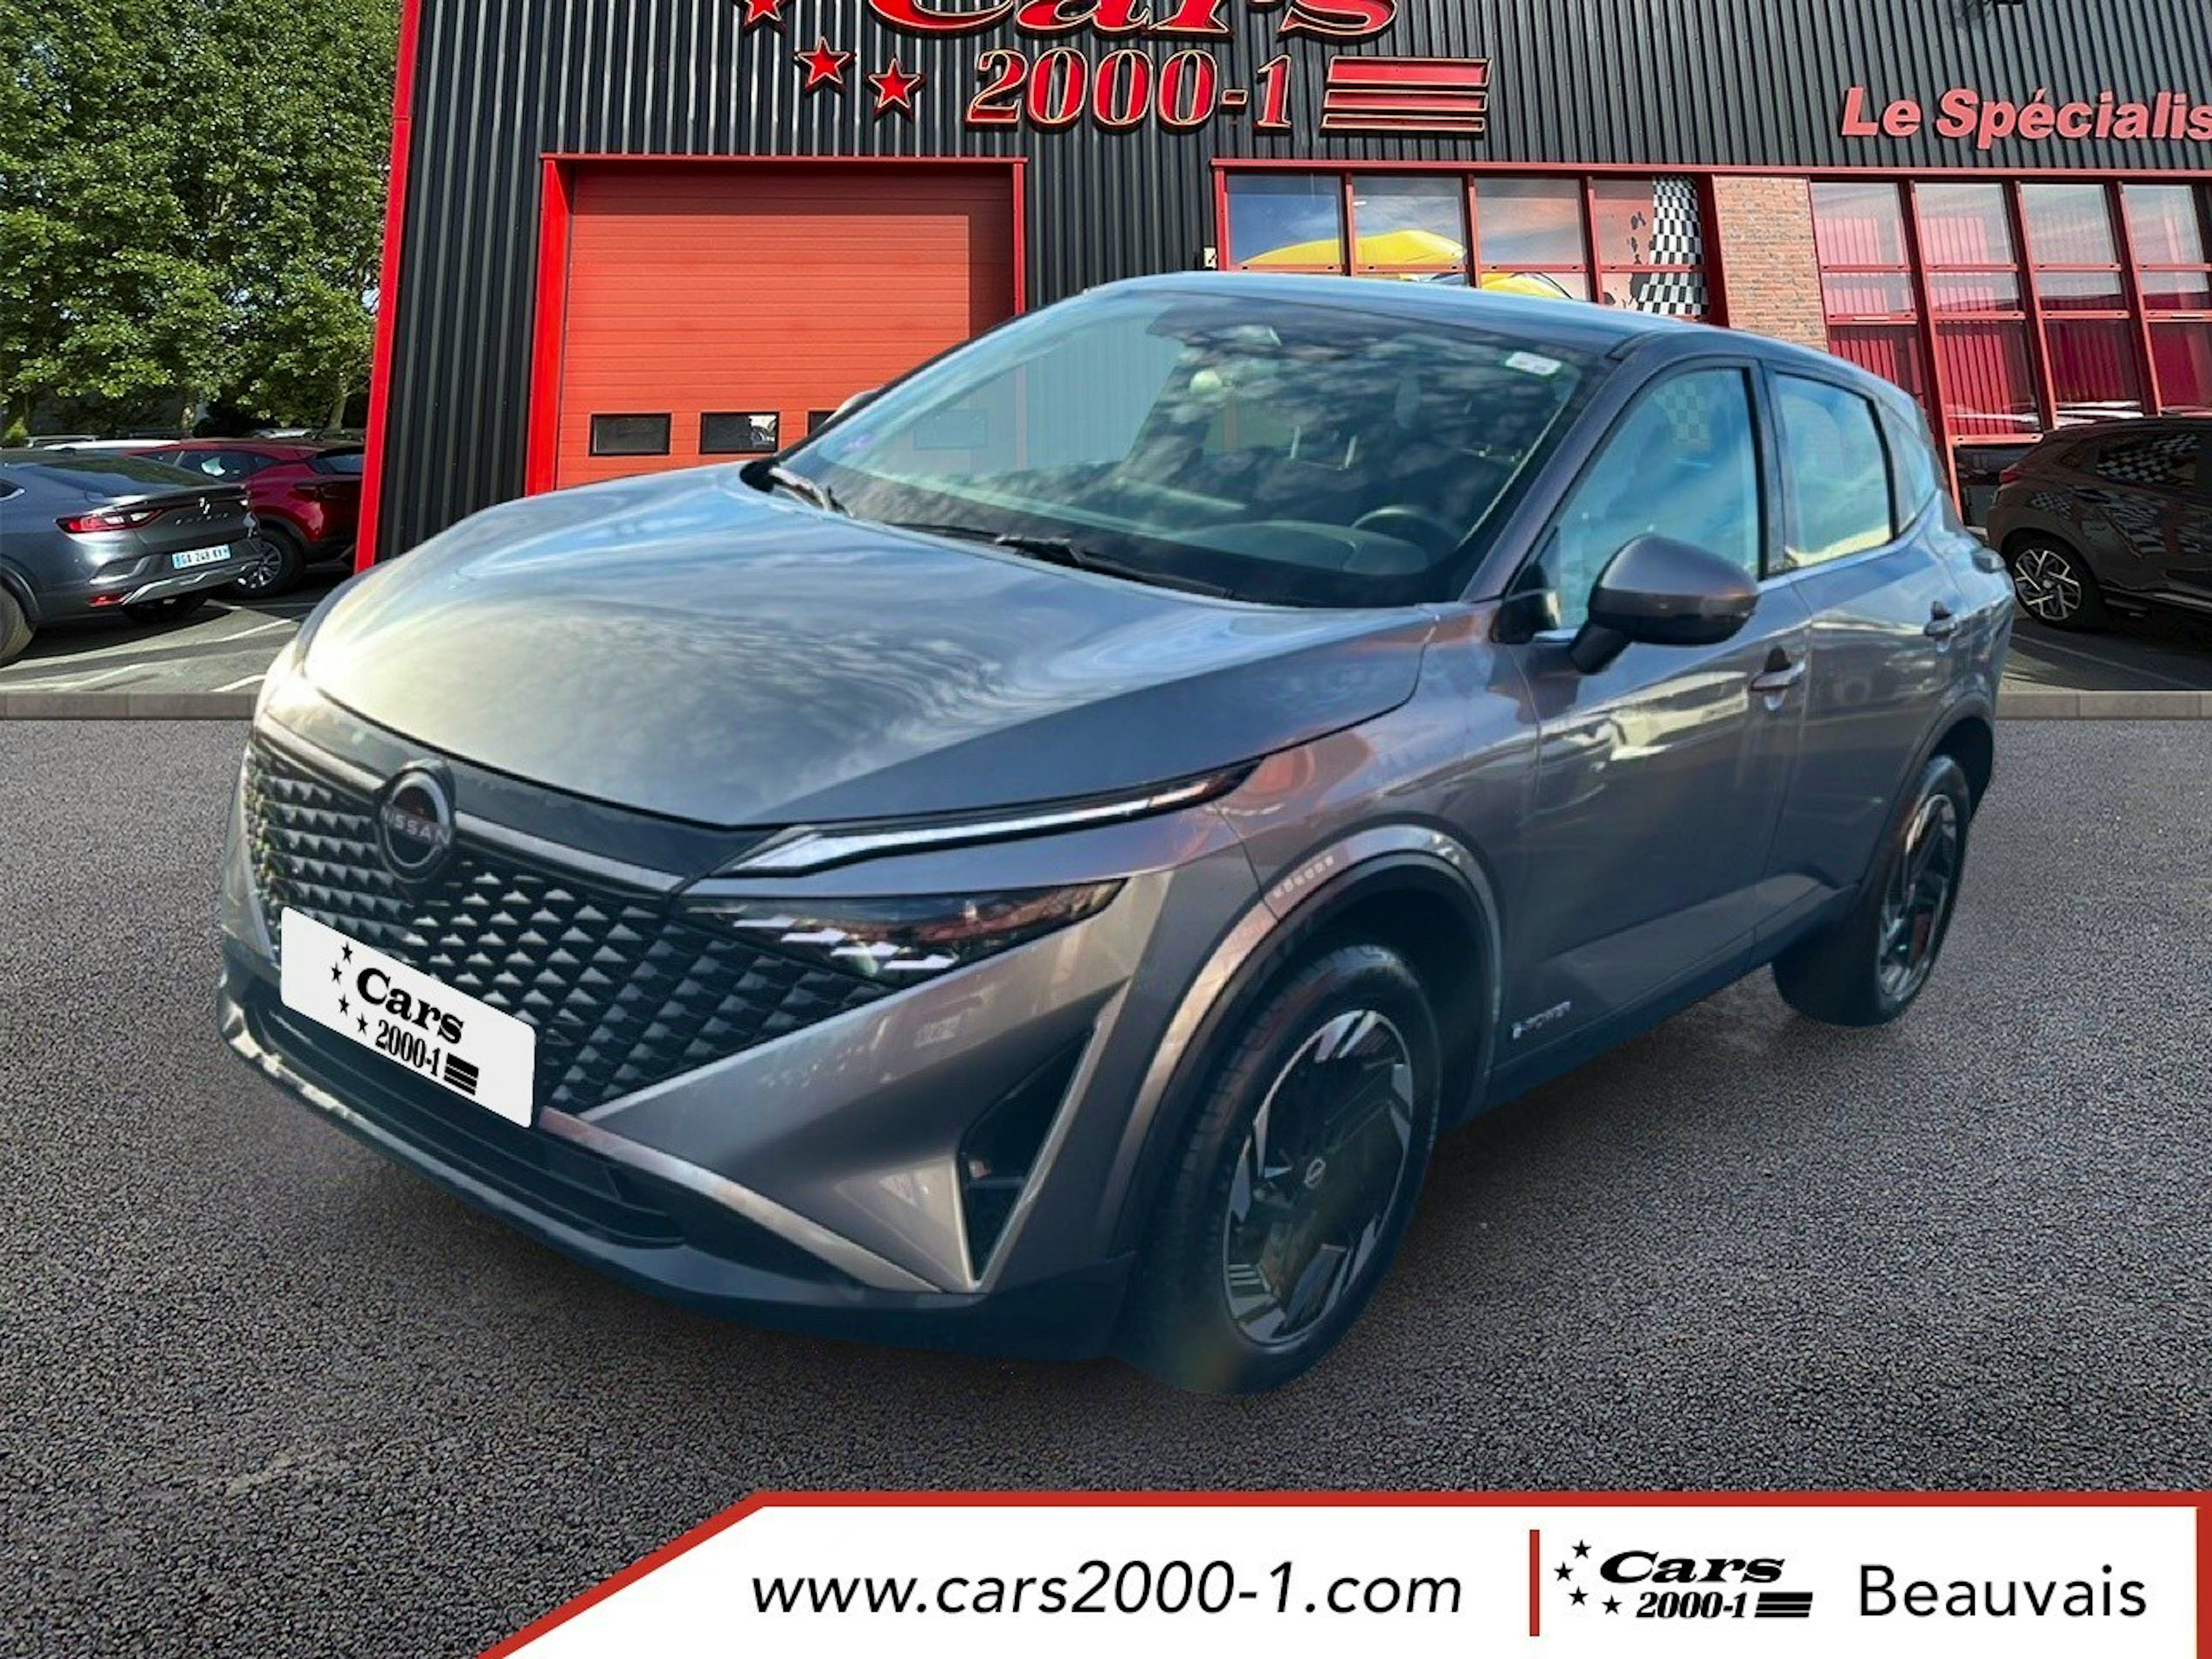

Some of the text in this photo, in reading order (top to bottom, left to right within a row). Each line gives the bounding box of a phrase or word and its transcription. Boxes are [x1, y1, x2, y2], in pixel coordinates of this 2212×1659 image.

[965, 49, 1293, 130] 2000-1
[1842, 87, 2212, 150] Le Spécialis
[381, 805, 452, 846] NISSAN
[356, 967, 465, 1044] Cars
[375, 1019, 440, 1077] 2000-1
